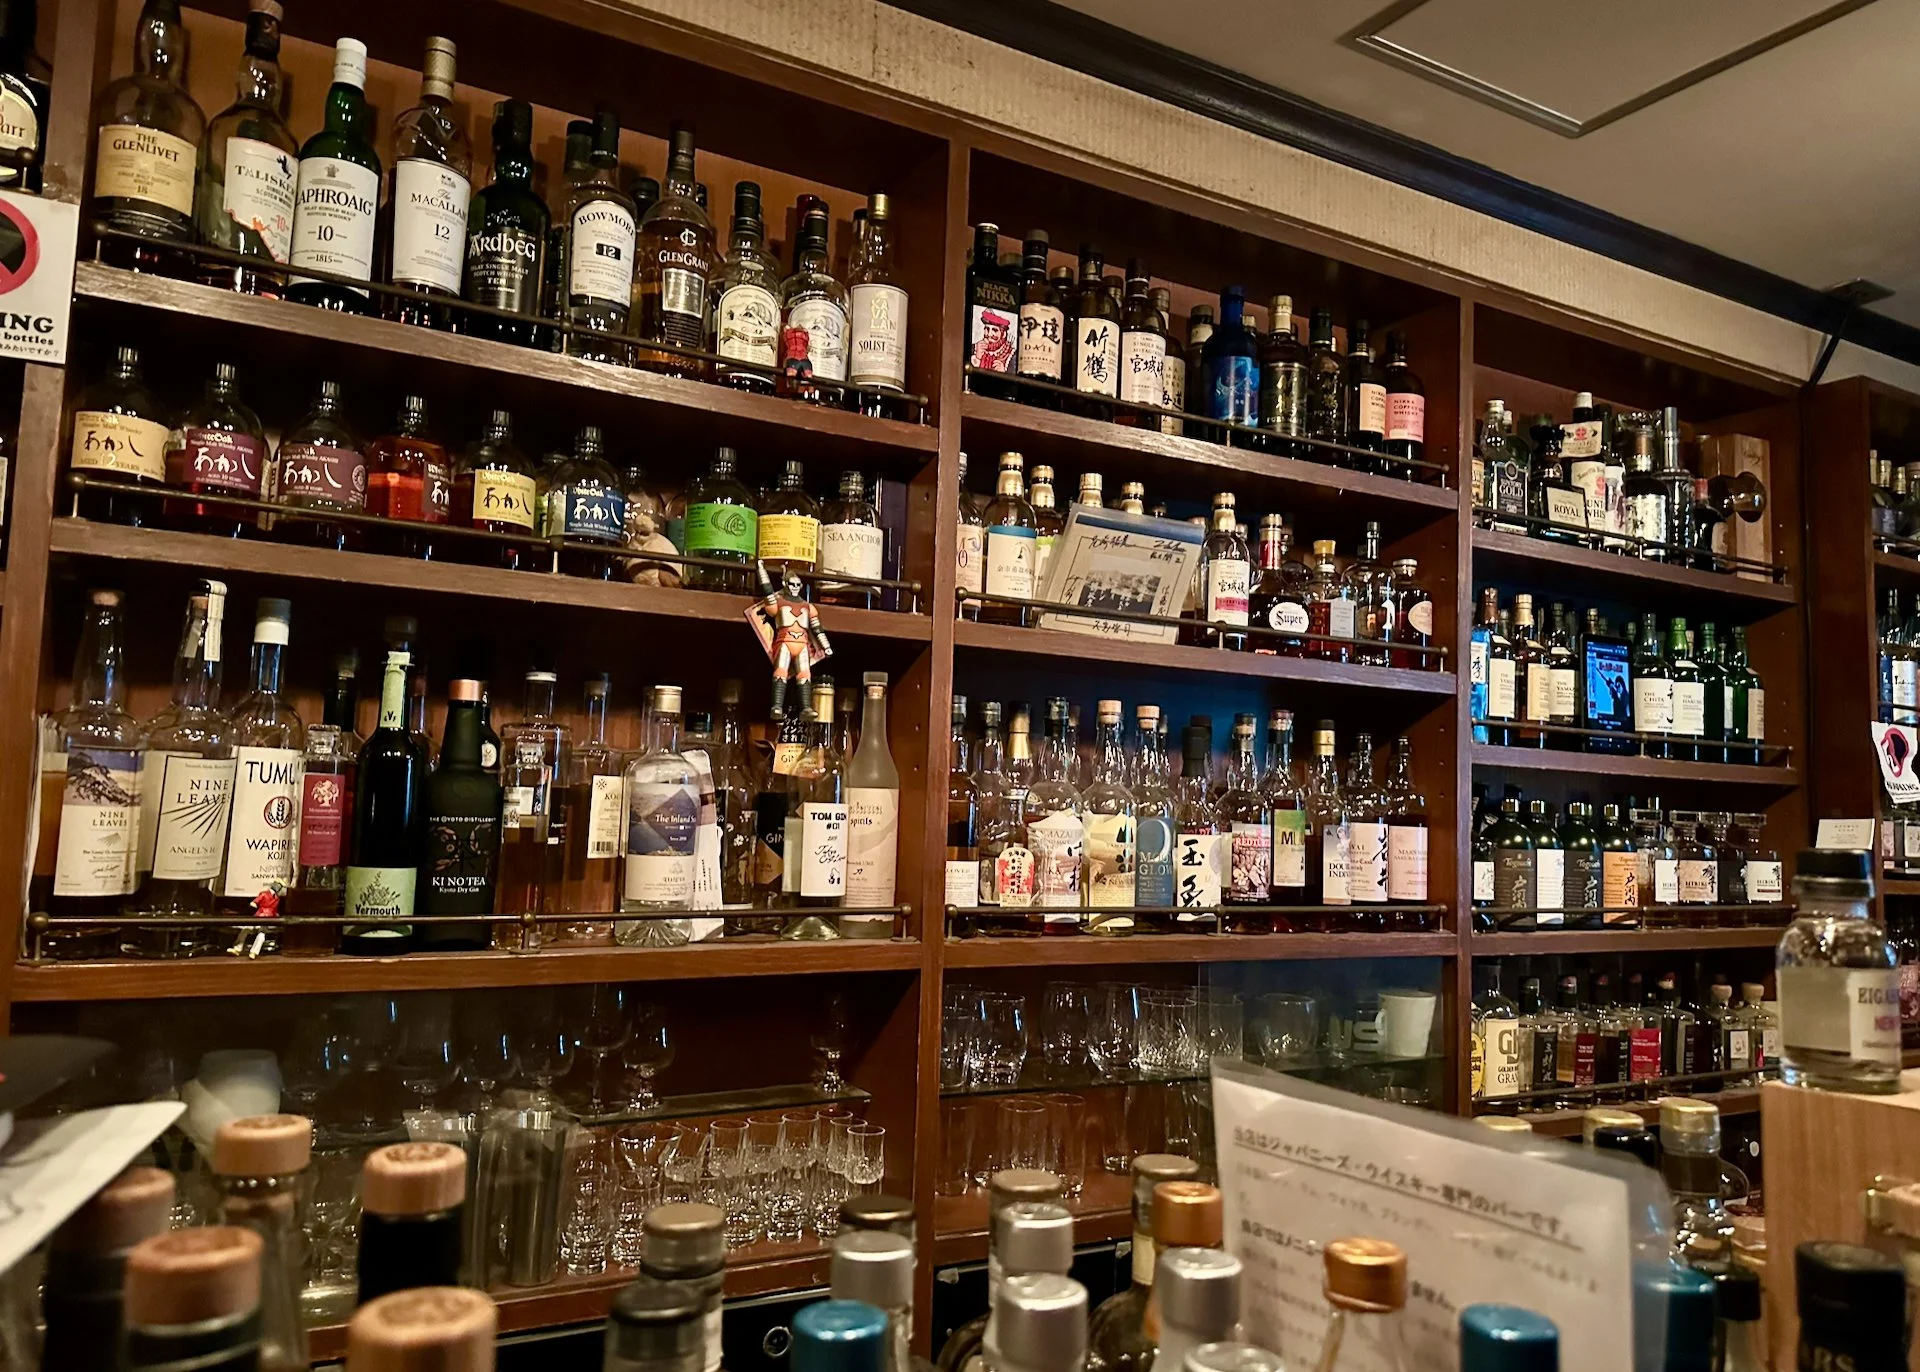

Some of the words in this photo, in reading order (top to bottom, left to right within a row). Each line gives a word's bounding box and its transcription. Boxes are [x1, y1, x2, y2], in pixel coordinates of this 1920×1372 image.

[136, 133, 158, 144] THE
[113, 139, 180, 162] GLENLIVET
[317, 225, 334, 242] 10
[435, 224, 450, 241] 12
[602, 245, 616, 258] 12
[315, 255, 333, 264] 1815
[487, 277, 507, 285] TEN
[976, 286, 1016, 306] NIKKA
[4, 332, 54, 345] bottles
[858, 339, 886, 355] SOLIST
[1024, 343, 1053, 353] DATE
[1083, 325, 1110, 384] 竹鶴
[84, 430, 144, 457] あかし
[194, 447, 255, 480] あかし
[284, 460, 343, 488] あかし
[1499, 484, 1524, 497] GOLD
[483, 487, 532, 516] あかし
[573, 497, 621, 526] あかし
[1554, 504, 1581, 518] ROYAL
[827, 531, 845, 543] SEA
[846, 533, 881, 546] ANCHOR
[1275, 610, 1304, 626] Super
[189, 779, 230, 790] NINE
[655, 813, 670, 823] The
[671, 814, 691, 824] Inland
[810, 812, 832, 820] TOM
[92, 819, 128, 827] LEAVES
[267, 852, 286, 860] KOJI
[432, 876, 445, 886] KI
[447, 876, 465, 886] NO
[465, 876, 486, 886] TEA
[457, 886, 469, 894] Dry
[355, 904, 401, 916] Vermouth
